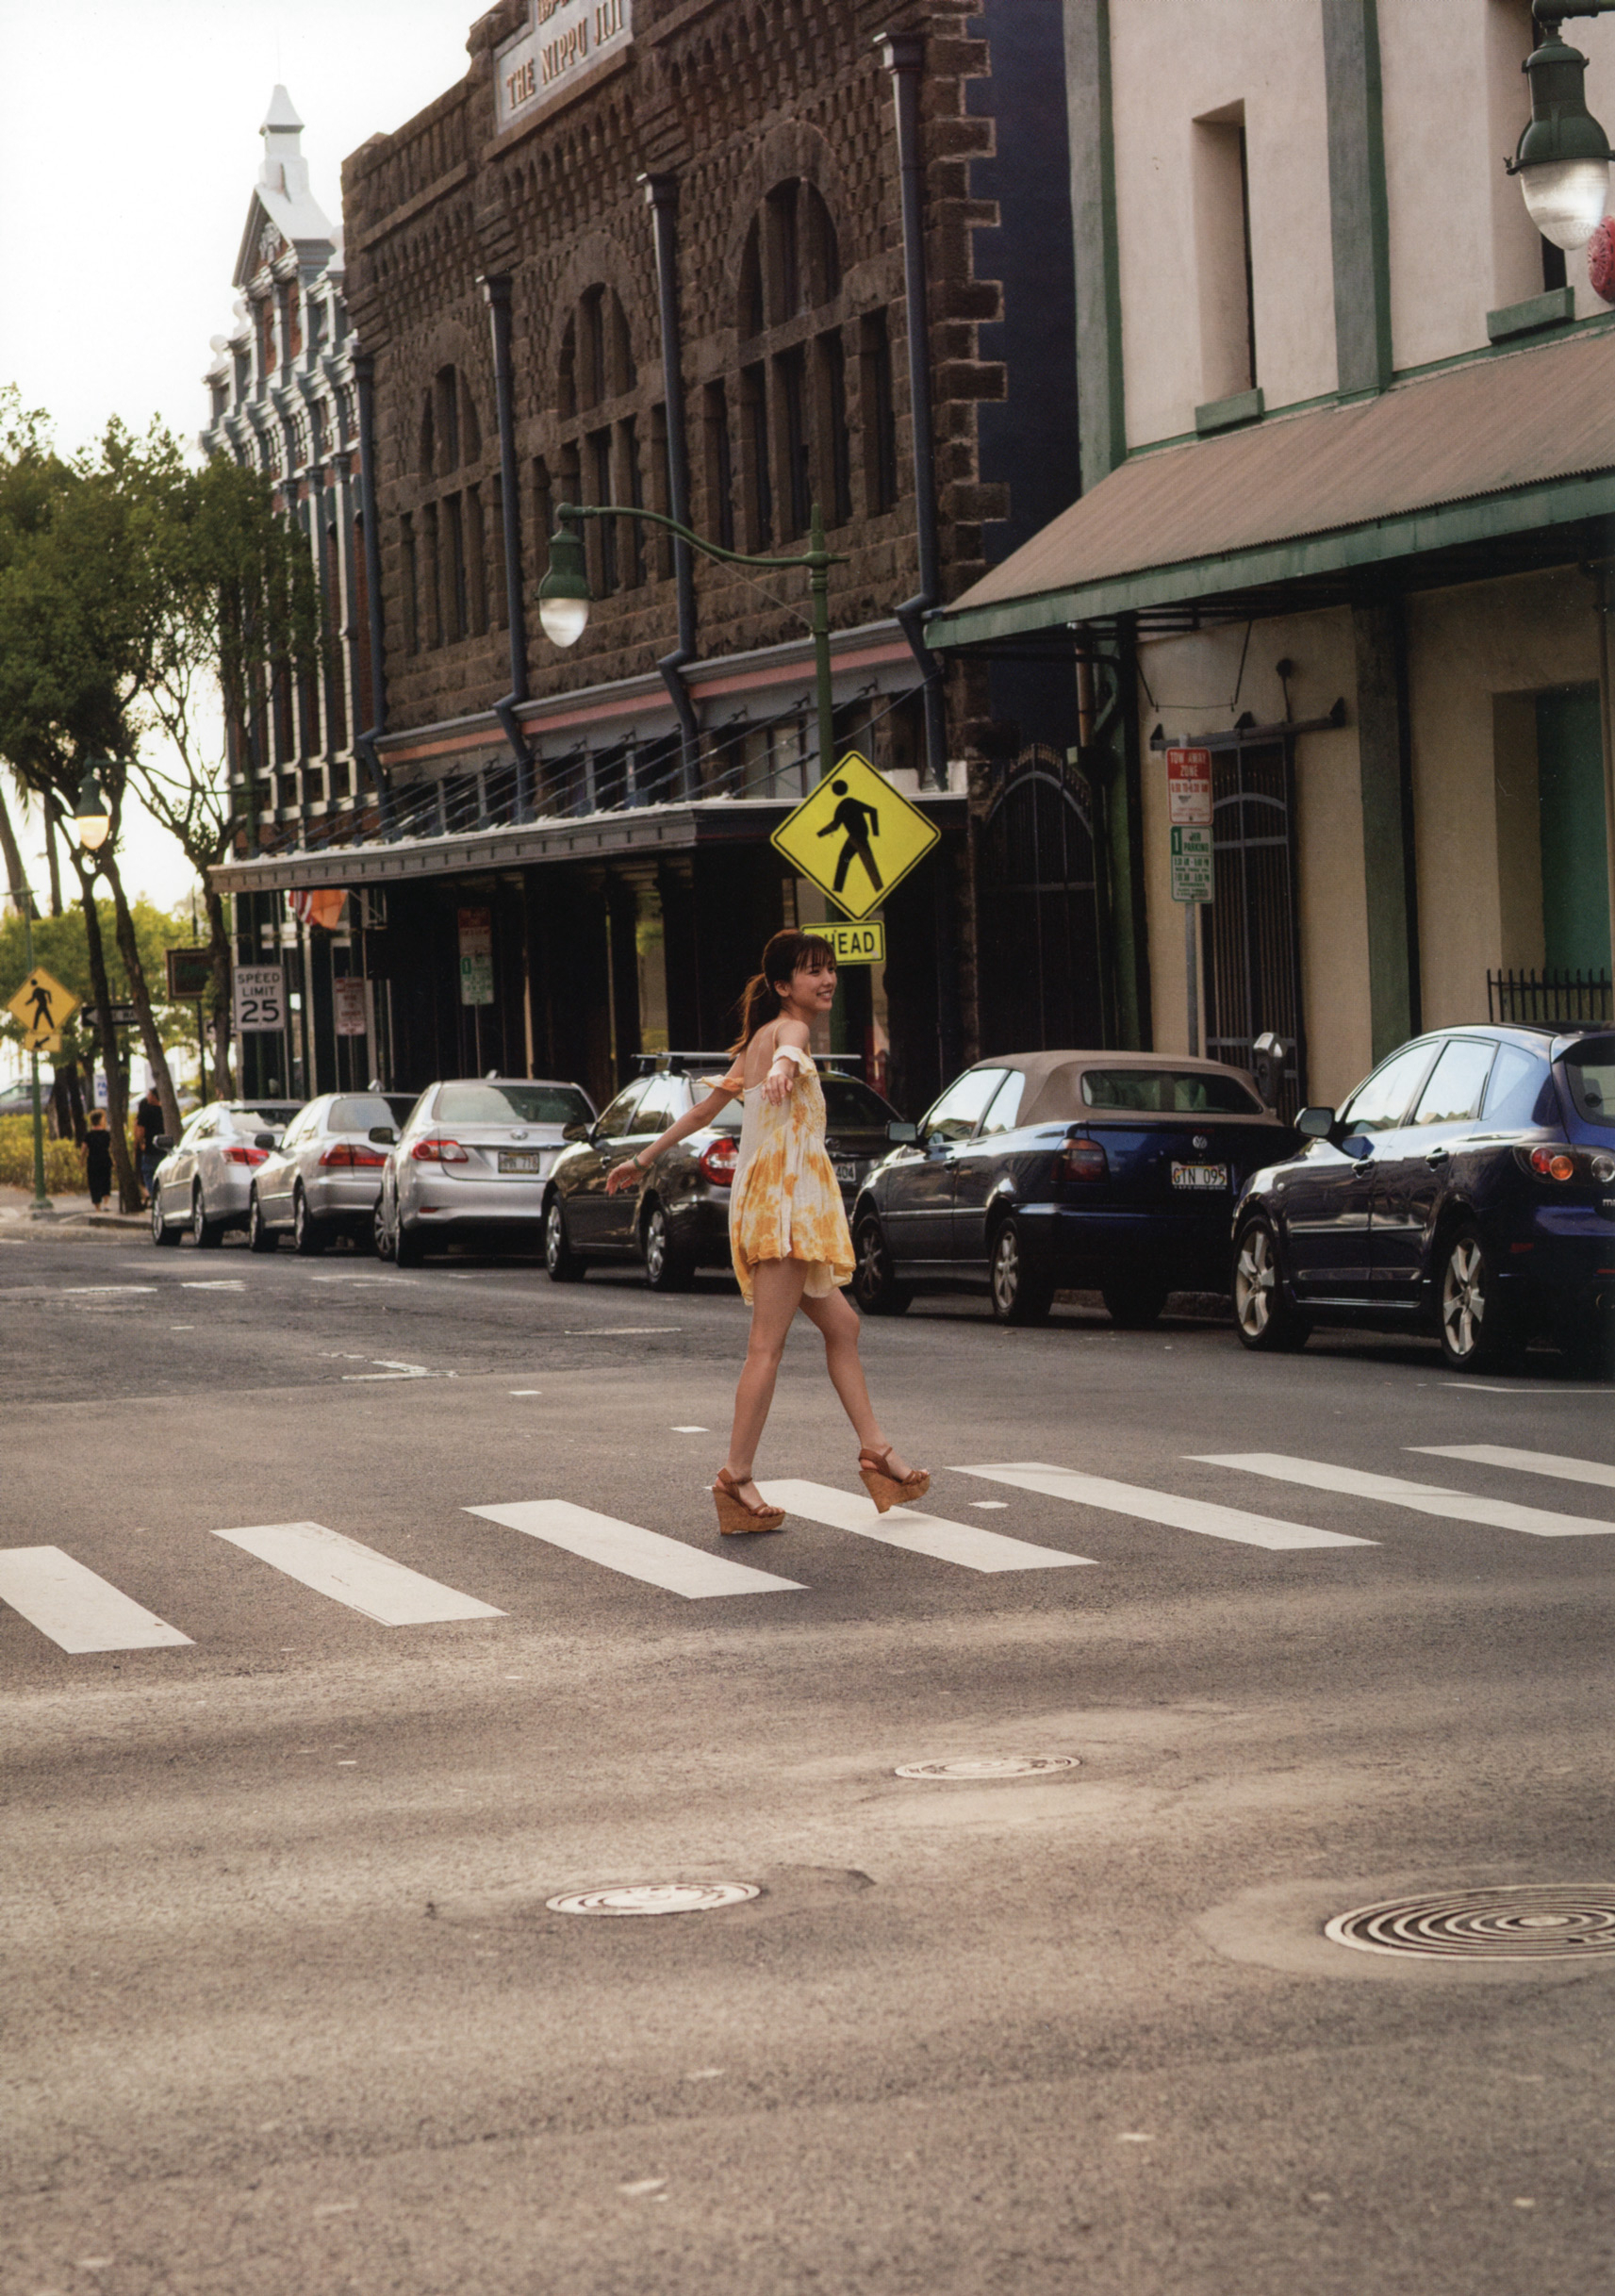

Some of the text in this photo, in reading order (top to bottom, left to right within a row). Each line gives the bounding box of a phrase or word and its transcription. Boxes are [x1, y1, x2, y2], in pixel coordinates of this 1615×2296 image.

[506, 58, 535, 109] THE
[539, 17, 586, 85] NIPPU
[592, 0, 622, 45] JIJI
[1169, 752, 1207, 765] TOW AWAY
[1180, 764, 1199, 778] ZONE
[1184, 842, 1210, 852] PARKING
[824, 931, 875, 954] HEAD
[238, 972, 280, 984] SPEED
[242, 985, 275, 997] LIMIT
[240, 999, 279, 1023] 25
[1173, 1168, 1226, 1185] GTN 095
